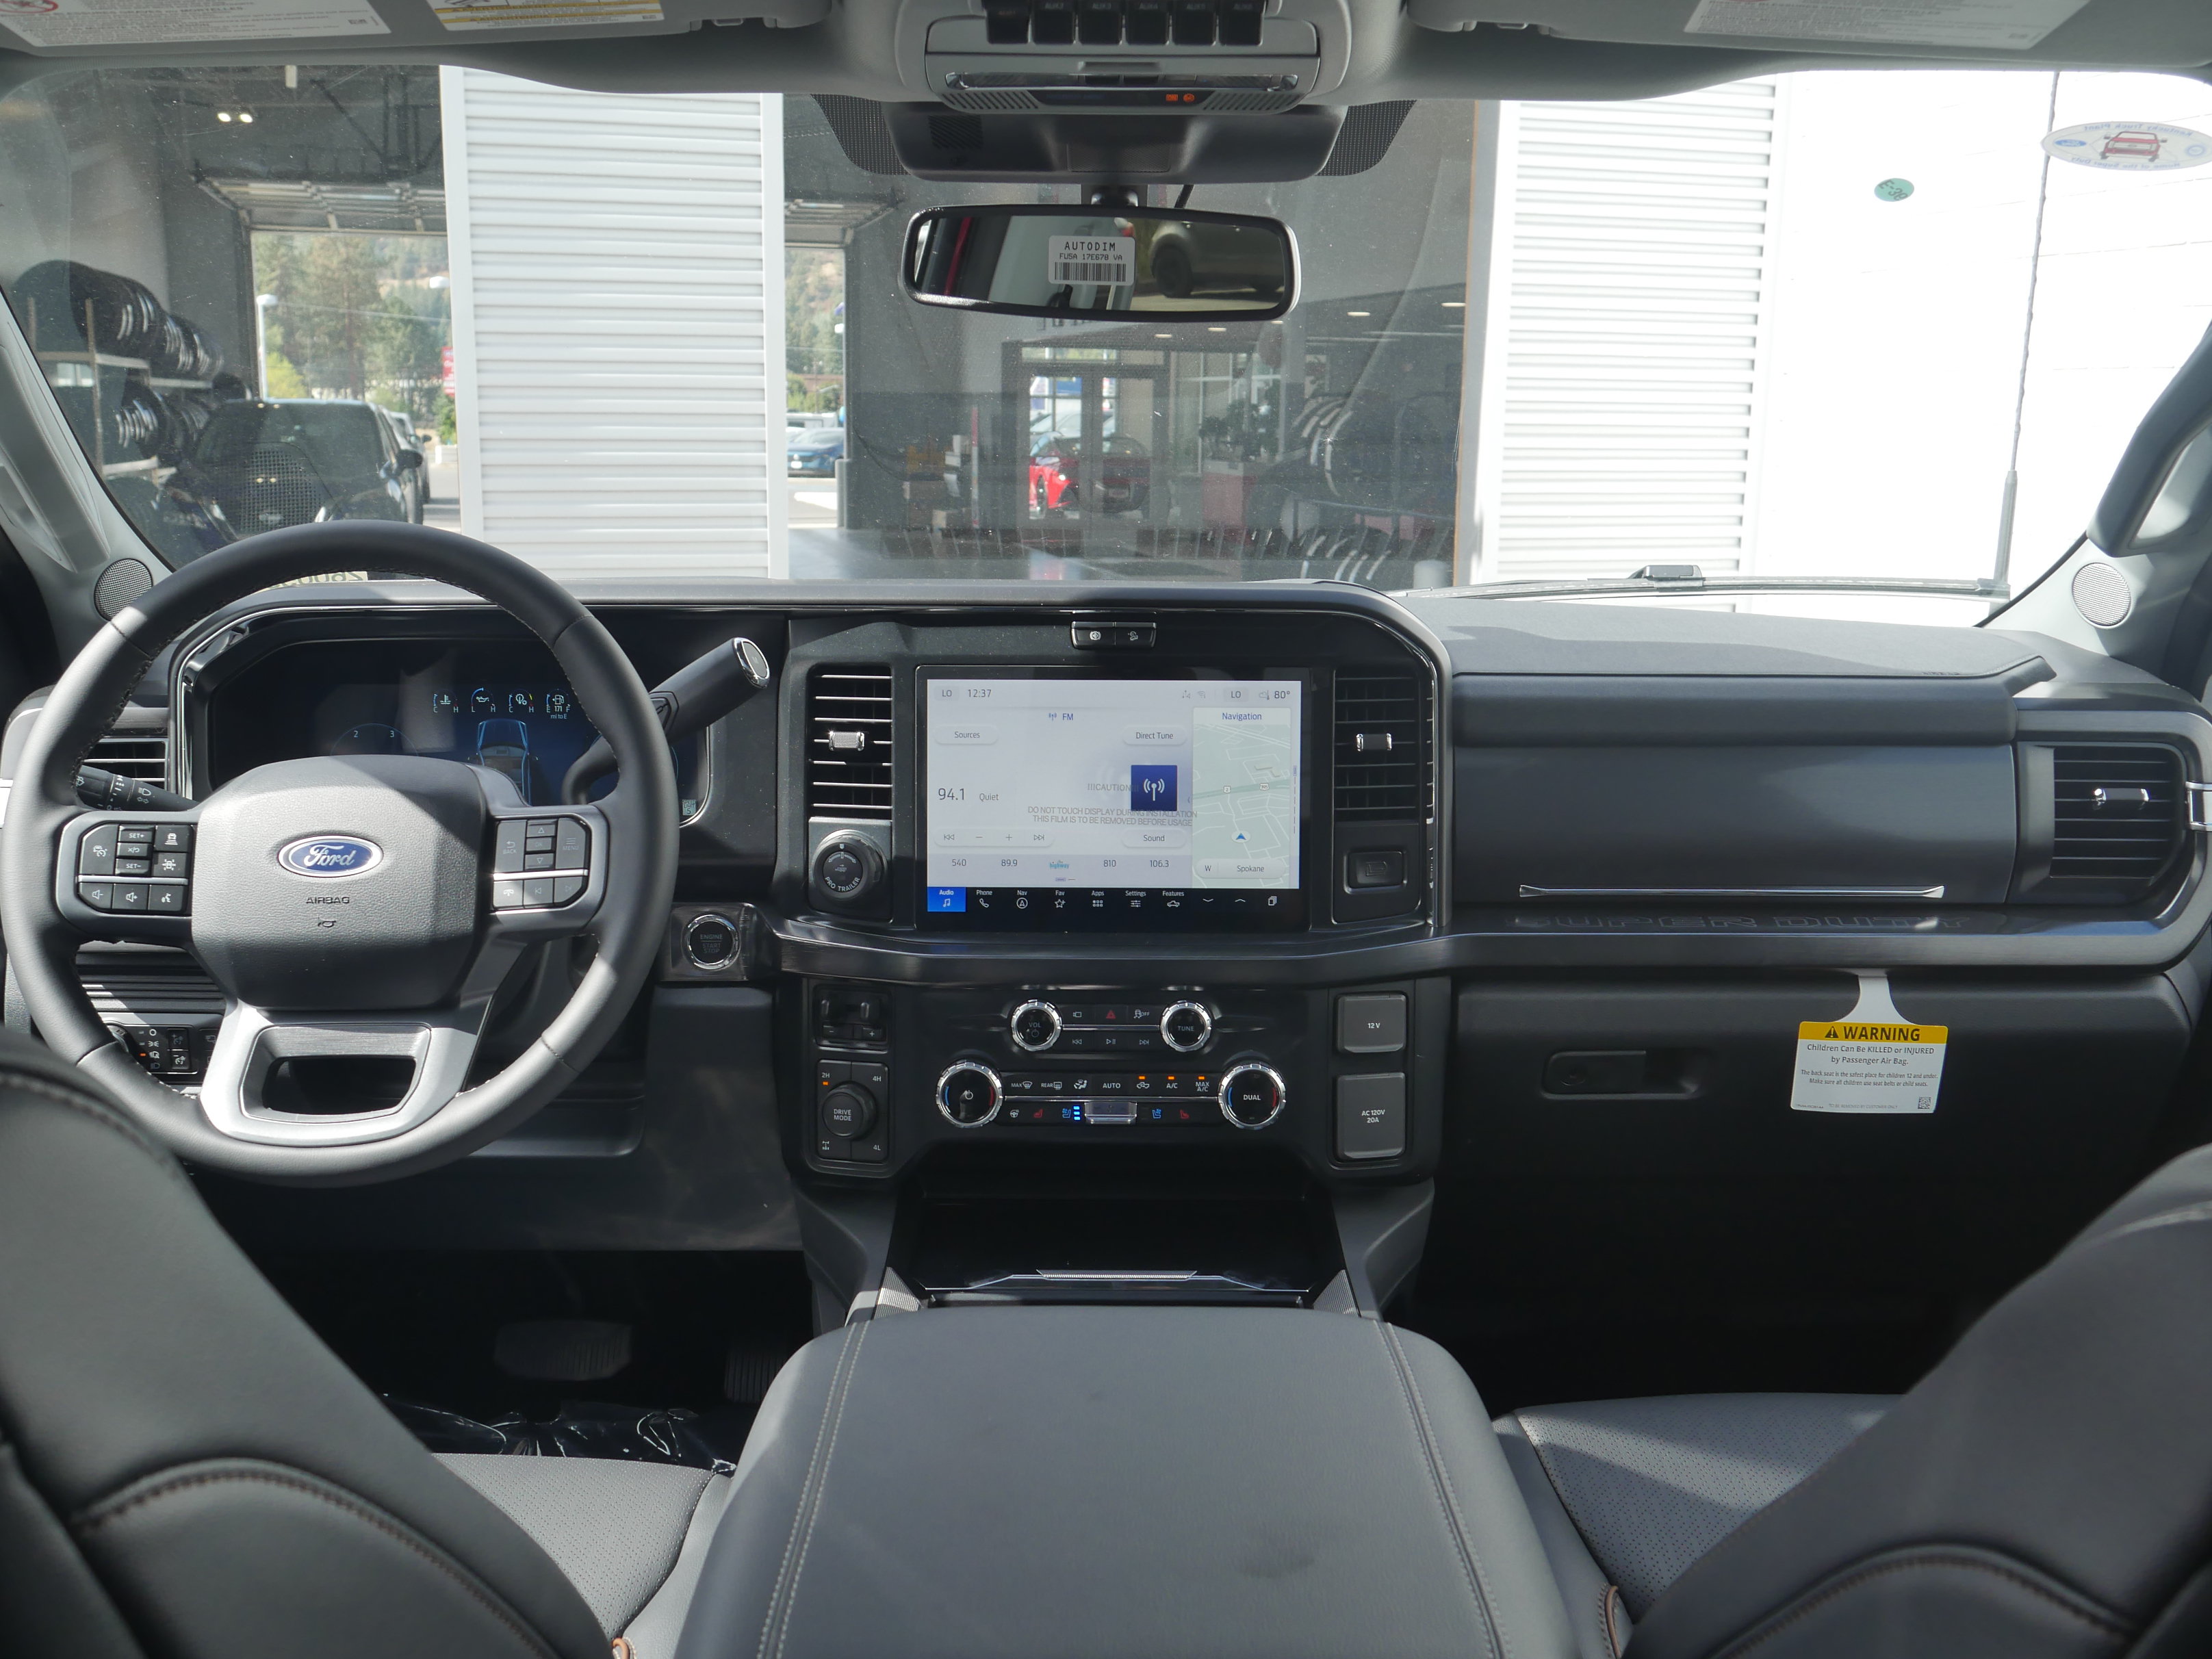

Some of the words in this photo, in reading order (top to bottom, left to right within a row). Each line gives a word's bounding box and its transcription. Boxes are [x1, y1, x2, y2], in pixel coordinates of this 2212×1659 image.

[1064, 242, 1116, 251] AUTODIM
[968, 689, 992, 697] 12:37
[1274, 691, 1290, 699] 80°
[1222, 712, 1262, 721] Navigation
[938, 788, 965, 801] 94.1
[979, 793, 999, 801] Quiet
[1057, 807, 1083, 815] TOUCH
[1085, 808, 1115, 816] DISPLAY
[1116, 808, 1144, 816] DURING
[1146, 810, 1198, 818] INSTALLATION
[1101, 817, 1137, 825] REMOVED
[1138, 818, 1167, 826] BEFORE
[1168, 819, 1193, 827] USAGE
[303, 845, 357, 866] Ford
[1103, 860, 1117, 868] 810
[1150, 860, 1170, 868] 106.3
[1237, 865, 1265, 874] Spokane
[824, 876, 836, 890] PRO
[838, 877, 860, 892] TRAILER
[306, 897, 350, 905] AIRBAG
[1843, 1026, 1920, 1042] WARNING
[1807, 1044, 1839, 1052] Children
[1904, 1047, 1935, 1055] INJURED
[1831, 1056, 1840, 1065] by
[1842, 1056, 1879, 1066] Passenger
[1893, 1058, 1909, 1066] Bag.
